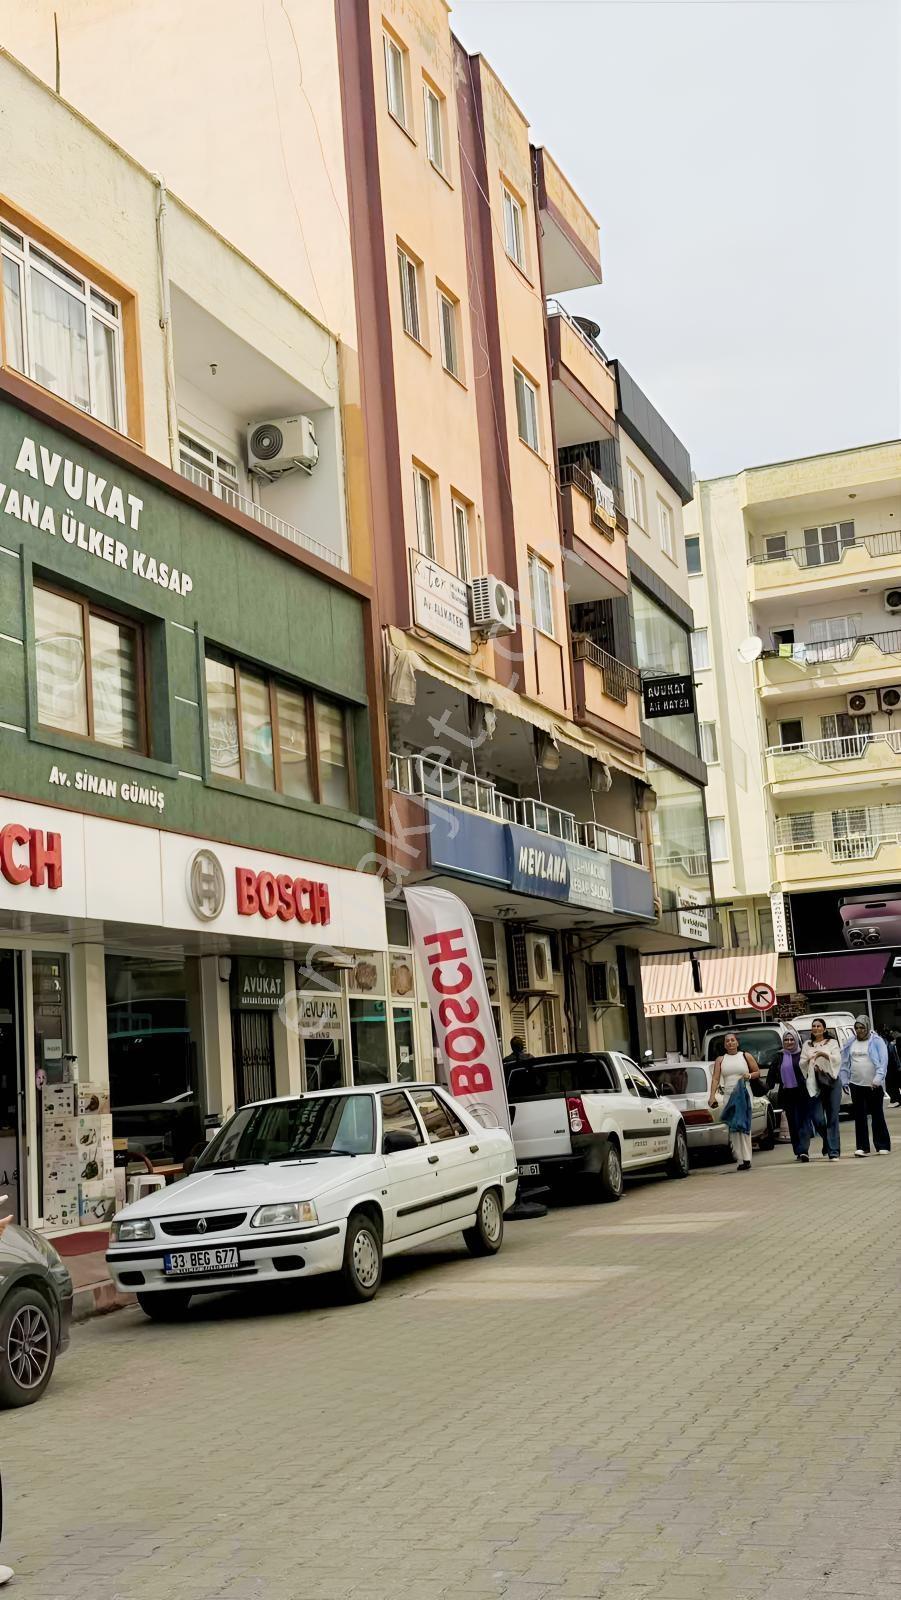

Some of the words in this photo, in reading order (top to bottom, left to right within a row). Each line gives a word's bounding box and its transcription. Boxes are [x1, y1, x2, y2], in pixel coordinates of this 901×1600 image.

[15, 437, 143, 531] AVUKAT
[61, 508, 128, 570] ÜLKER
[132, 550, 193, 596] KASAP
[48, 766, 71, 787] Av.
[74, 769, 117, 798] SİNAN
[121, 781, 165, 814] GÜMÜŞ
[519, 846, 567, 885] MEVLANA
[235, 866, 331, 926] BOSCH
[243, 975, 281, 995] AVUKAT
[171, 1254, 186, 1268] 33
[190, 1251, 210, 1267] BEG
[215, 1248, 235, 1264] 677
